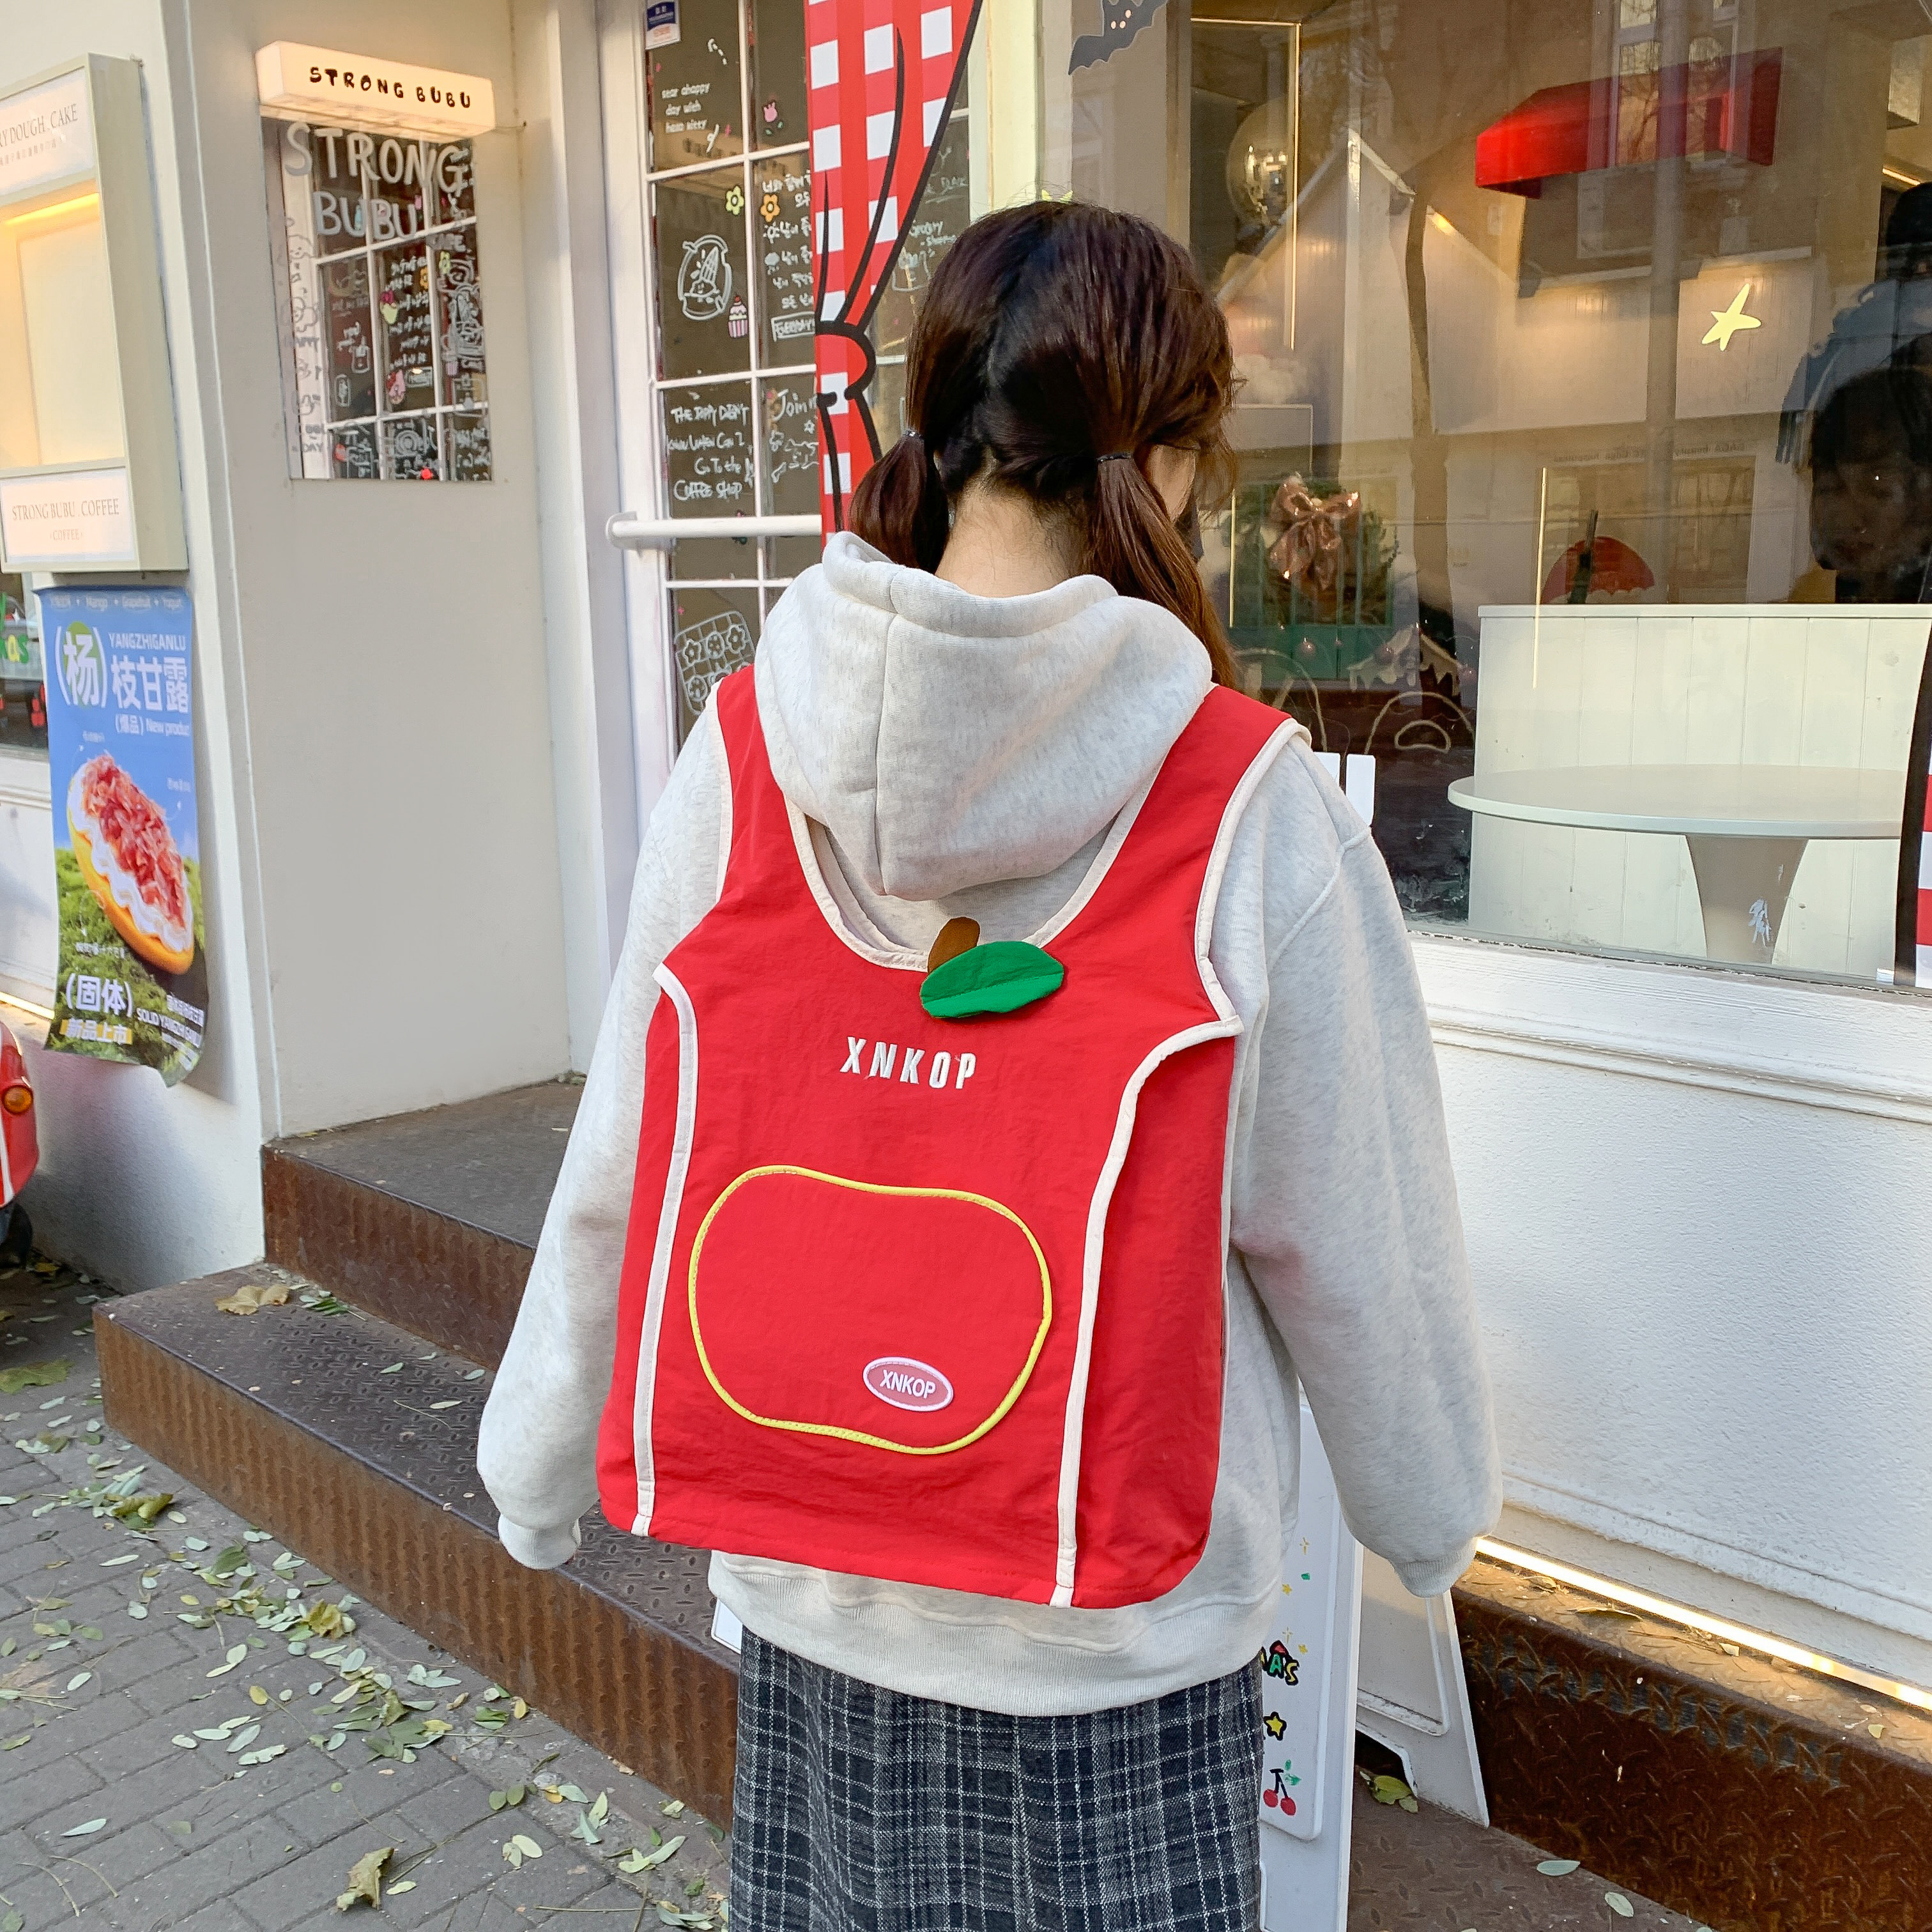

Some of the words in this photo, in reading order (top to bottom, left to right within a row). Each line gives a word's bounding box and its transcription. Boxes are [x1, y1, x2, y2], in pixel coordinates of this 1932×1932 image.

[309, 66, 404, 98] STRONG
[416, 86, 471, 109] BUBU
[50, 103, 79, 129] CAKE
[285, 122, 470, 197] STRONG
[313, 191, 417, 240] BUBU
[12, 503, 49, 521] STRONG
[50, 501, 75, 519] BUBU
[81, 498, 119, 517] COFFEE
[108, 632, 187, 652] YANGZHIGANLU
[110, 654, 189, 714] 枝甘露
[66, 1016, 128, 1045] 新品上市
[839, 1036, 977, 1089] XNKOP
[879, 1369, 936, 1399] XNKOP
